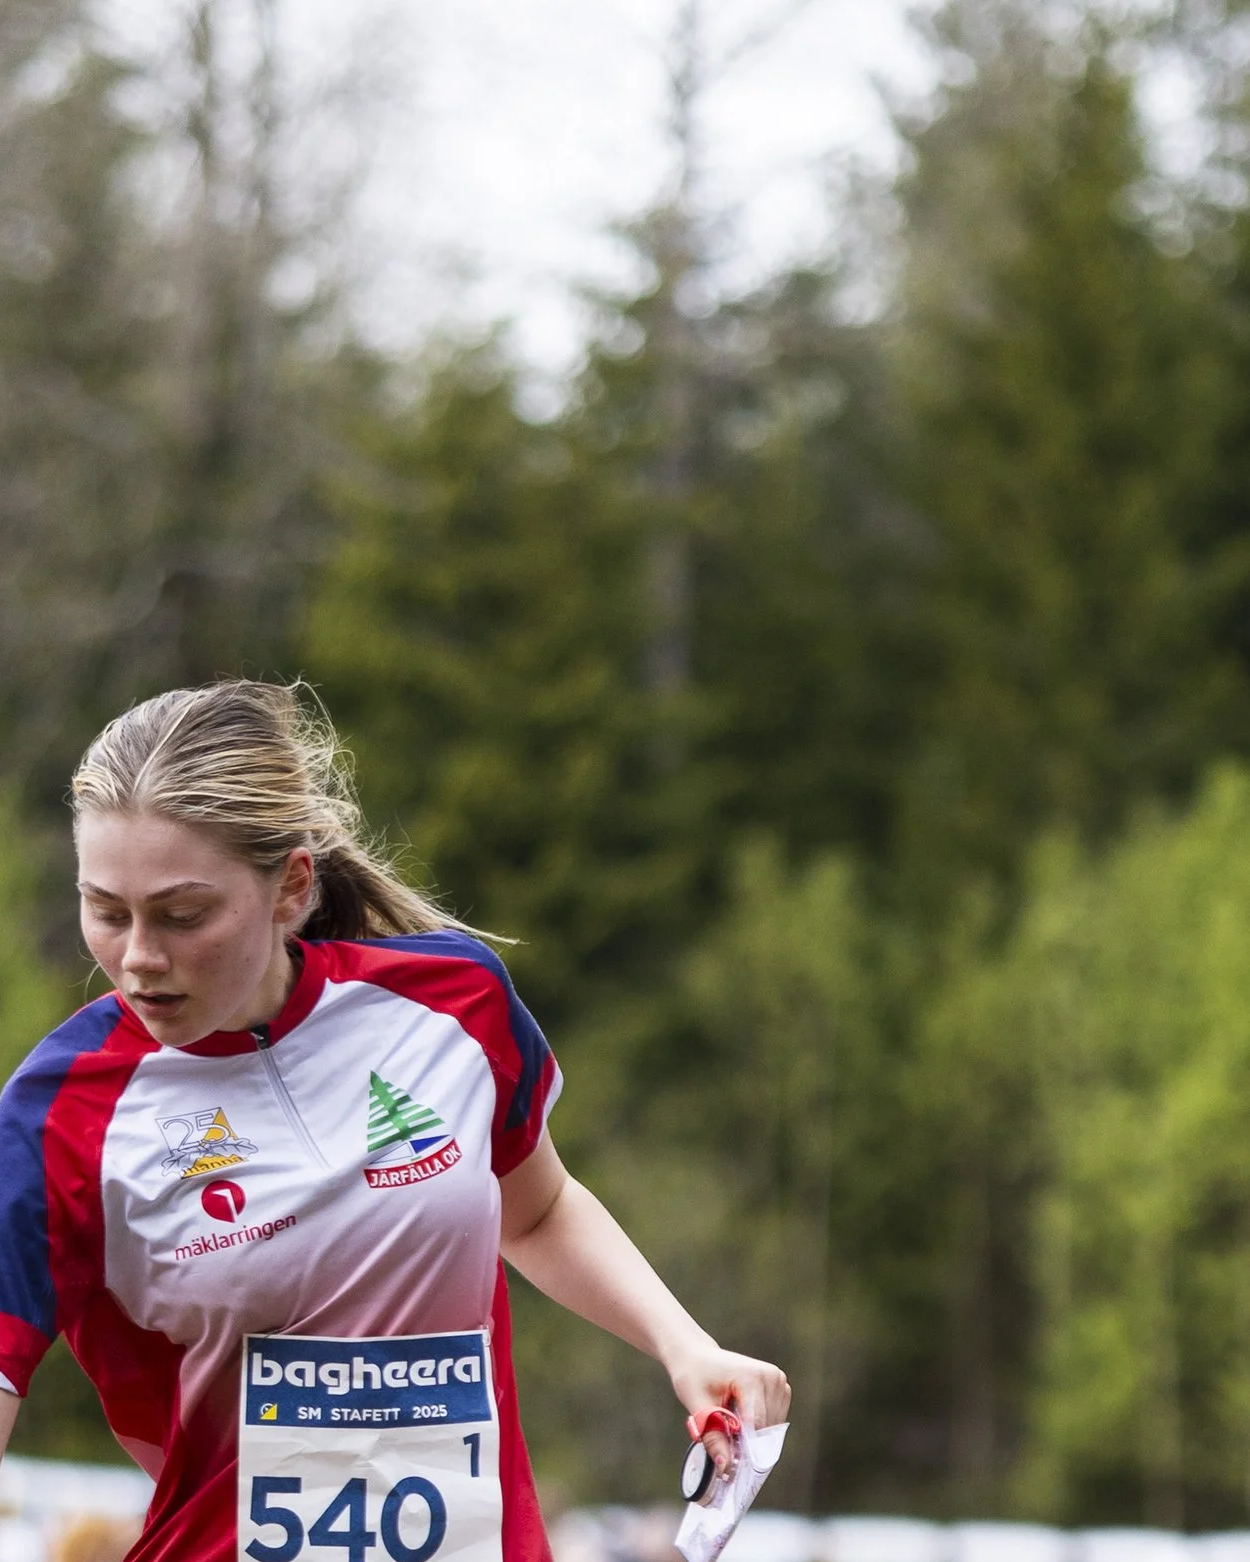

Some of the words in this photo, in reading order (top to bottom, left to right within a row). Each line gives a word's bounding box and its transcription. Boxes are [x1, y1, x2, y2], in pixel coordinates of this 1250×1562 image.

[162, 1113, 230, 1151] 25
[370, 1158, 445, 1187] JÄRFÄLLA
[442, 1145, 461, 1165] OK
[175, 1215, 297, 1260] mäklarringen
[251, 1353, 481, 1395] bagheera
[298, 1406, 322, 1420] SM
[330, 1407, 401, 1421] STAFETT
[412, 1405, 448, 1419] 2025
[462, 1433, 481, 1477] 1
